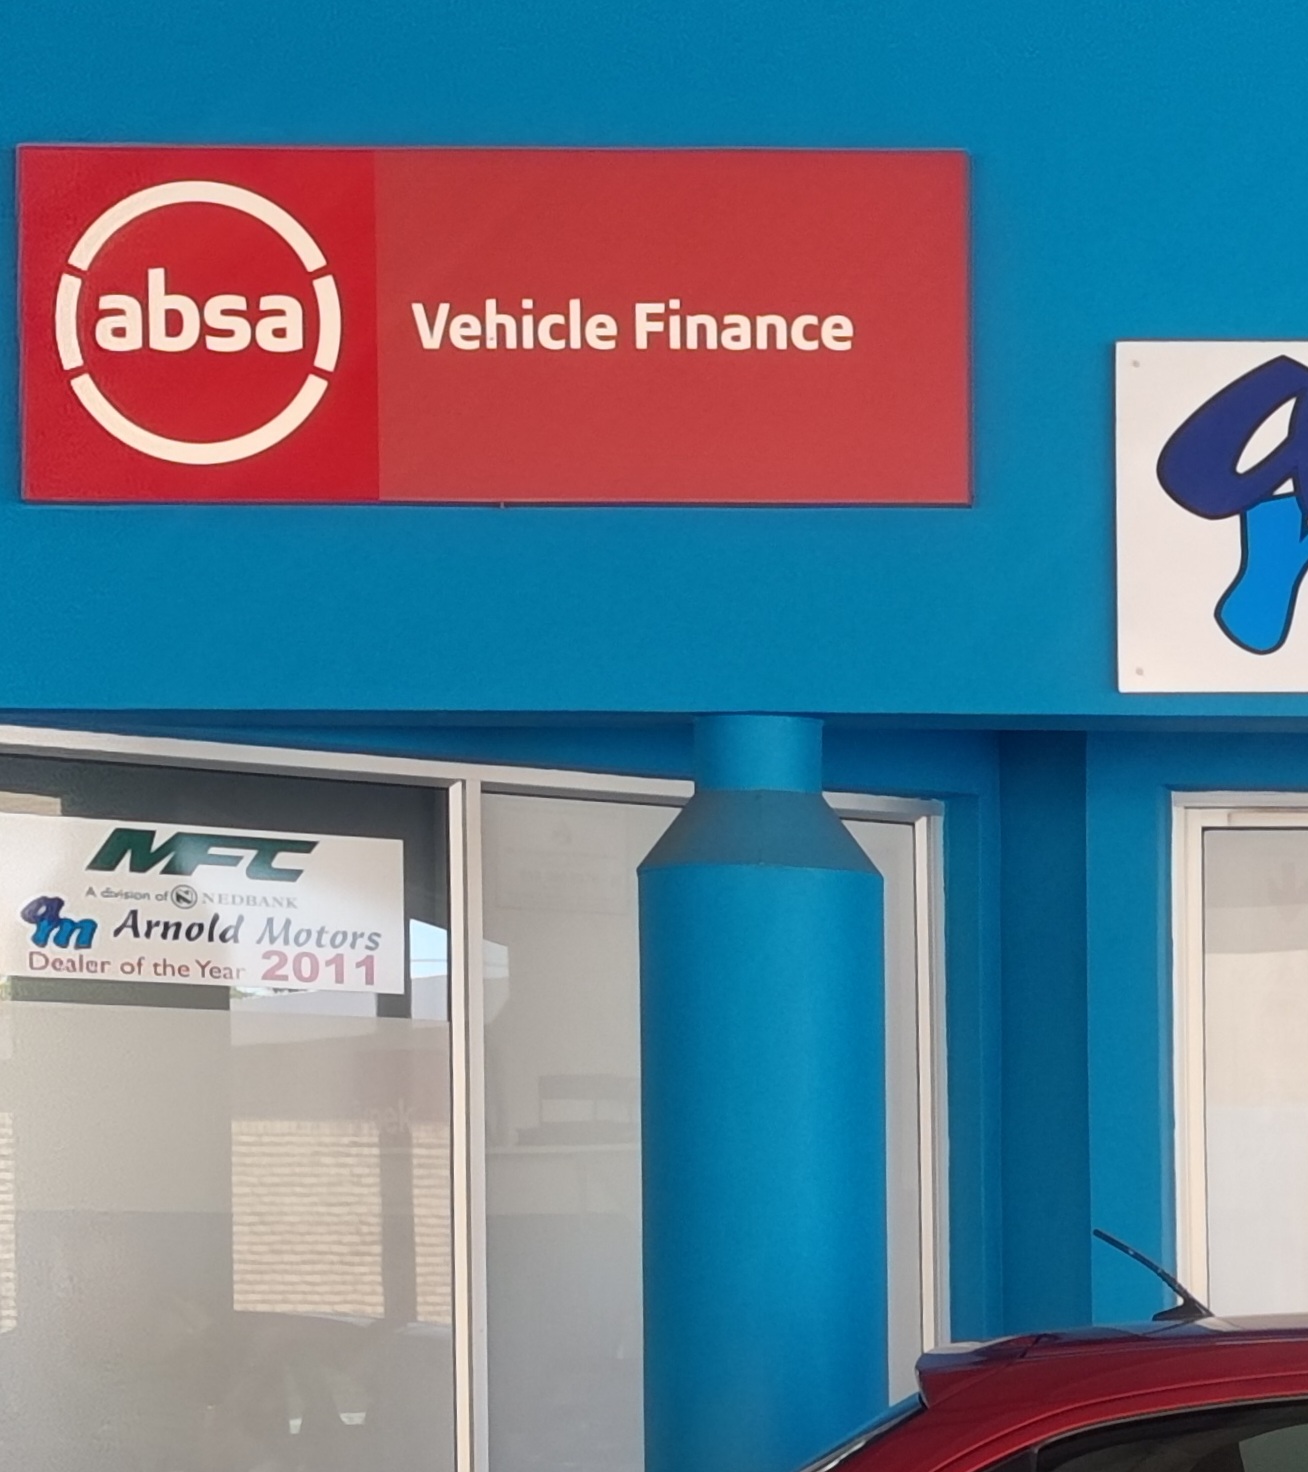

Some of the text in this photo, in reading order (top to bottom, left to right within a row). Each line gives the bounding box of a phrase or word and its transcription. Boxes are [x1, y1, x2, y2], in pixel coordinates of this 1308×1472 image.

[95, 267, 304, 353] absa
[411, 298, 854, 352] Vehicle Finance
[85, 827, 320, 883] MFC
[85, 886, 97, 898] A
[155, 890, 170, 901] of
[201, 891, 299, 909] NEDBANK
[113, 909, 382, 951] Arnold Motors
[28, 949, 375, 986] Dealer of the Year 2011
